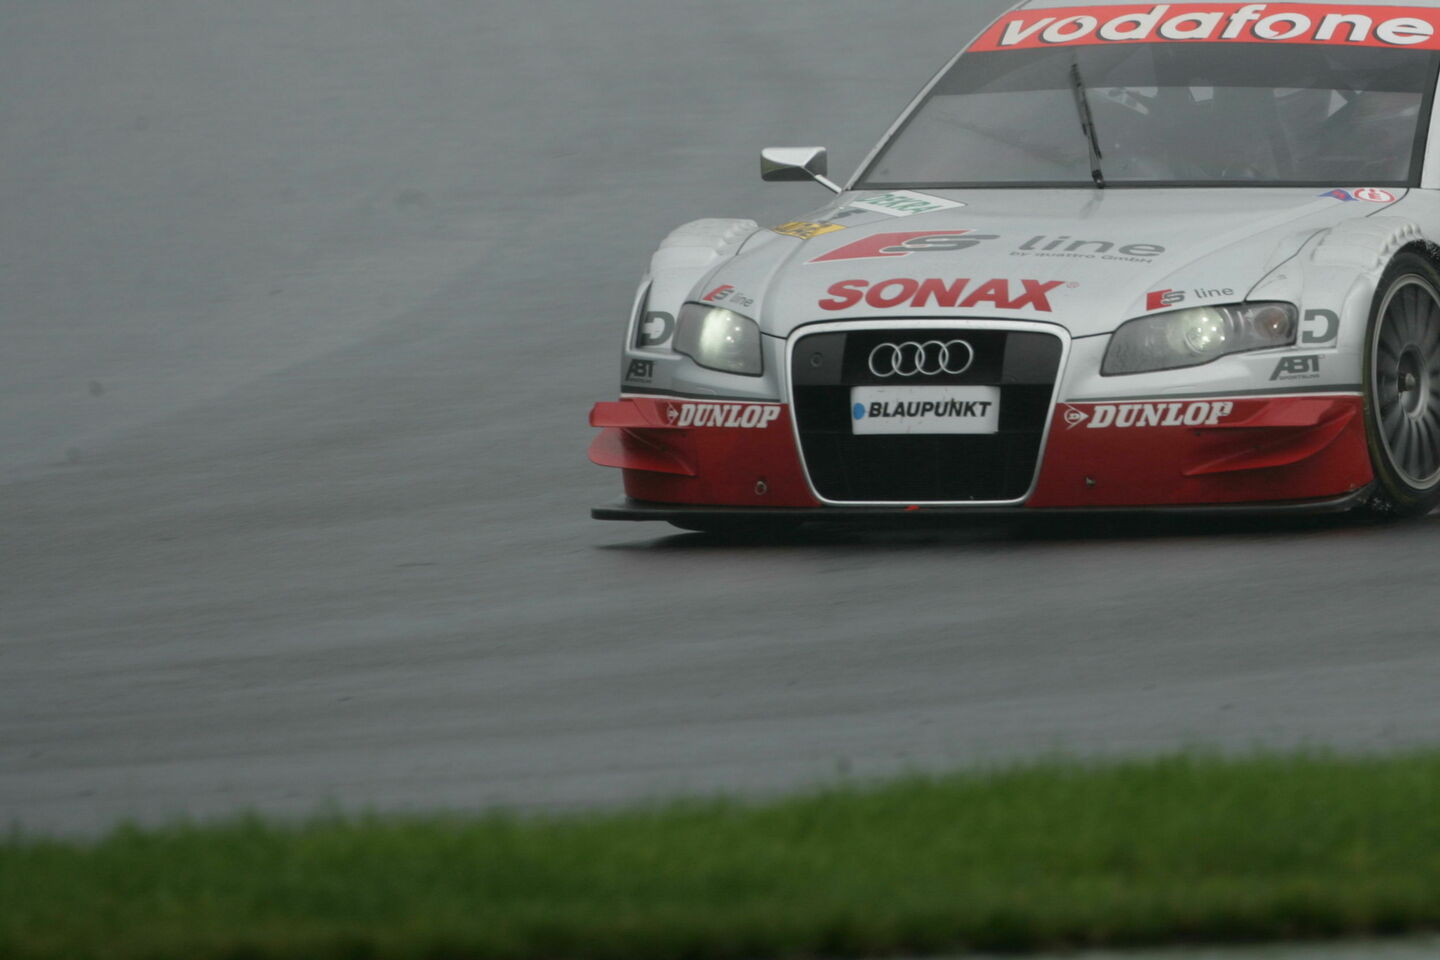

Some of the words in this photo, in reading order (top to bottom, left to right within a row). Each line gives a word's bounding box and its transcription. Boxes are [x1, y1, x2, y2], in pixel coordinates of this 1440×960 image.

[998, 3, 1436, 47] vodafone
[1018, 235, 1166, 257] line
[818, 277, 1066, 312] SONAX
[1194, 286, 1235, 300] line
[625, 358, 656, 382] ABT
[1268, 354, 1321, 381] ABT
[678, 403, 782, 428] DUNLOP
[867, 398, 992, 419] BLAUPUNKT
[1086, 401, 1233, 429] DUNLOP
